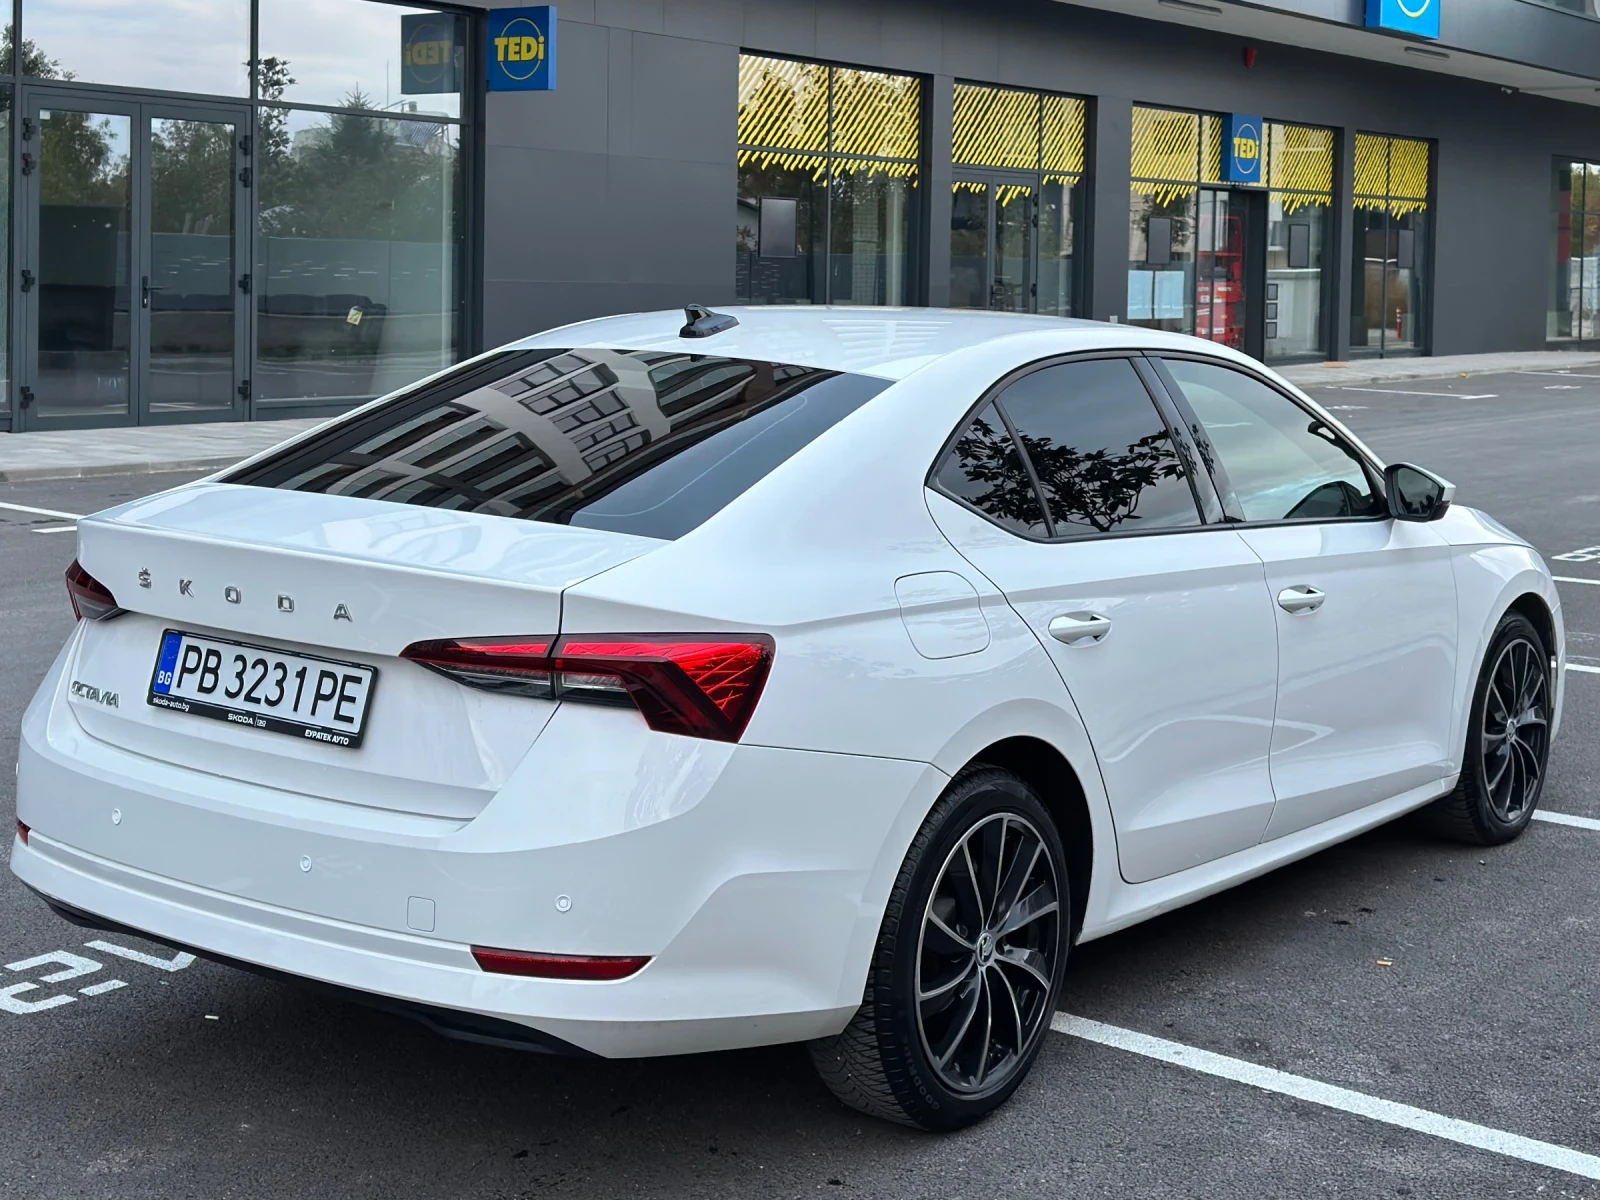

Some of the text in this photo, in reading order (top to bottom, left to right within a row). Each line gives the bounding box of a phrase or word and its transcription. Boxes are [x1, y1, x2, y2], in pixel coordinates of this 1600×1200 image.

[494, 36, 545, 62] TEDi
[1233, 137, 1259, 159] TEDi
[138, 566, 353, 623] ŠKODA
[157, 670, 172, 686] BG
[176, 644, 363, 724] PB 3231 PE
[71, 680, 120, 709] OCTAVIA
